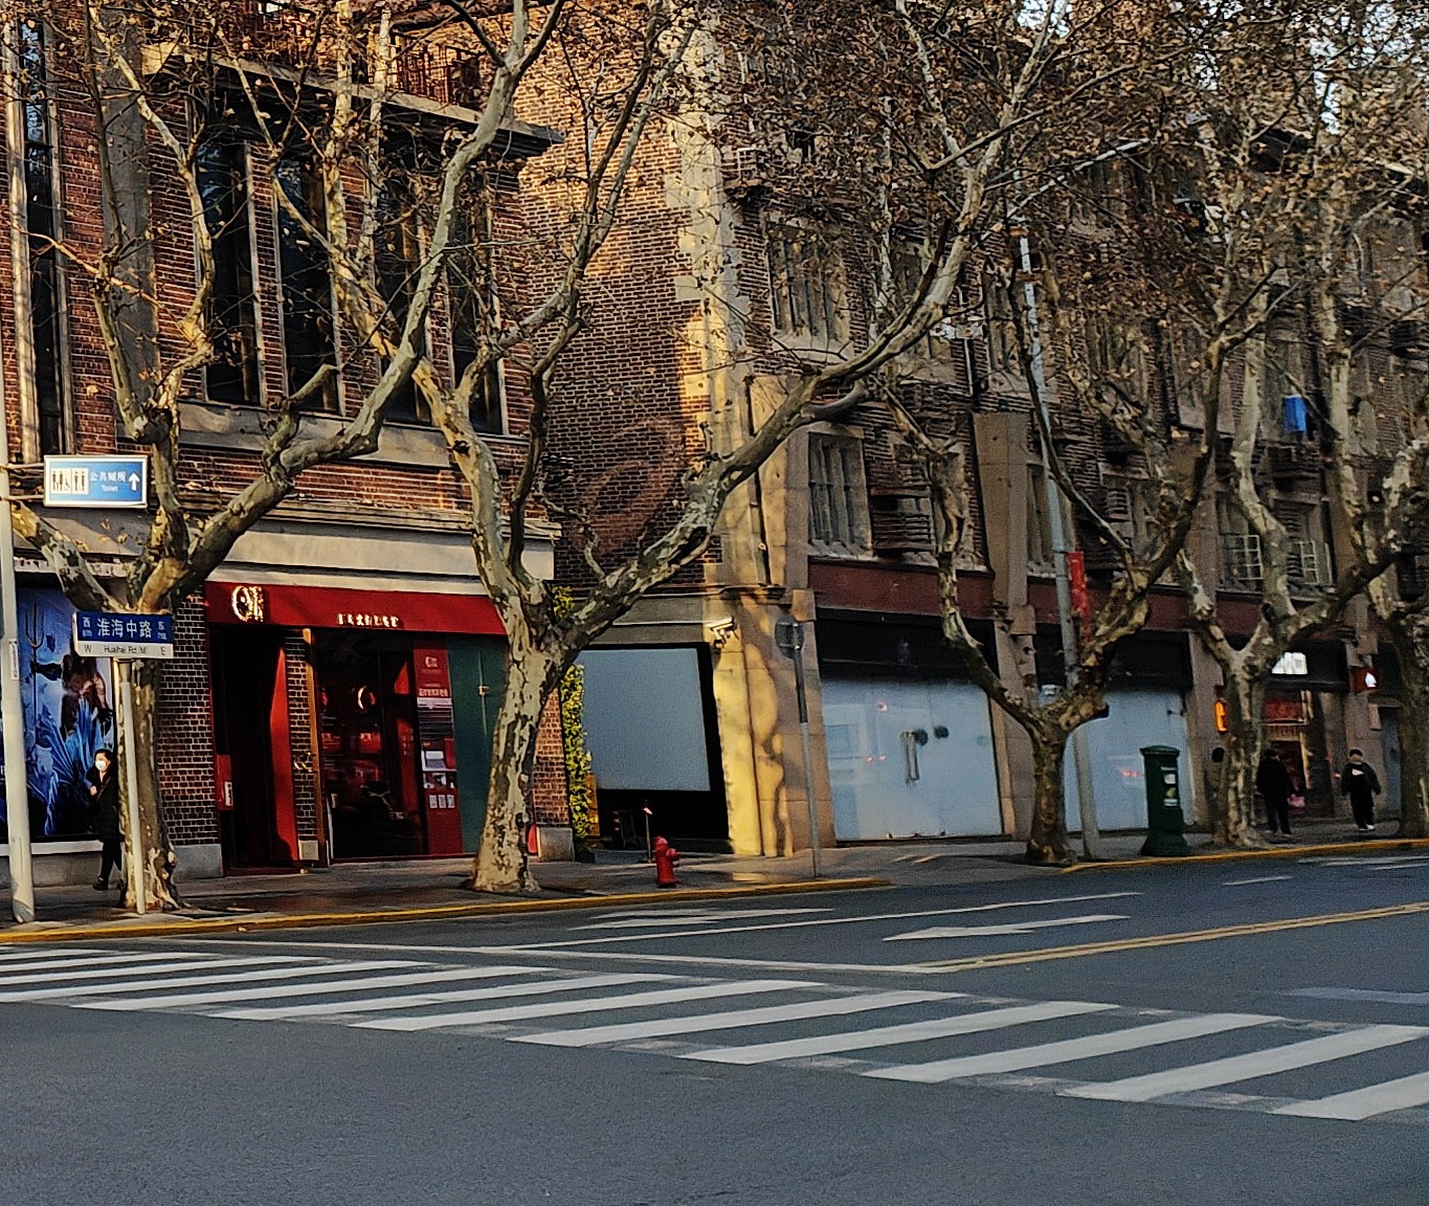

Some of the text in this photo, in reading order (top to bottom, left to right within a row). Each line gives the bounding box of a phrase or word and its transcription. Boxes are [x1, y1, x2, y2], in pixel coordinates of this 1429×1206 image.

[97, 618, 152, 638] 淮海中路
[84, 644, 91, 653] W
[160, 646, 166, 656] E
